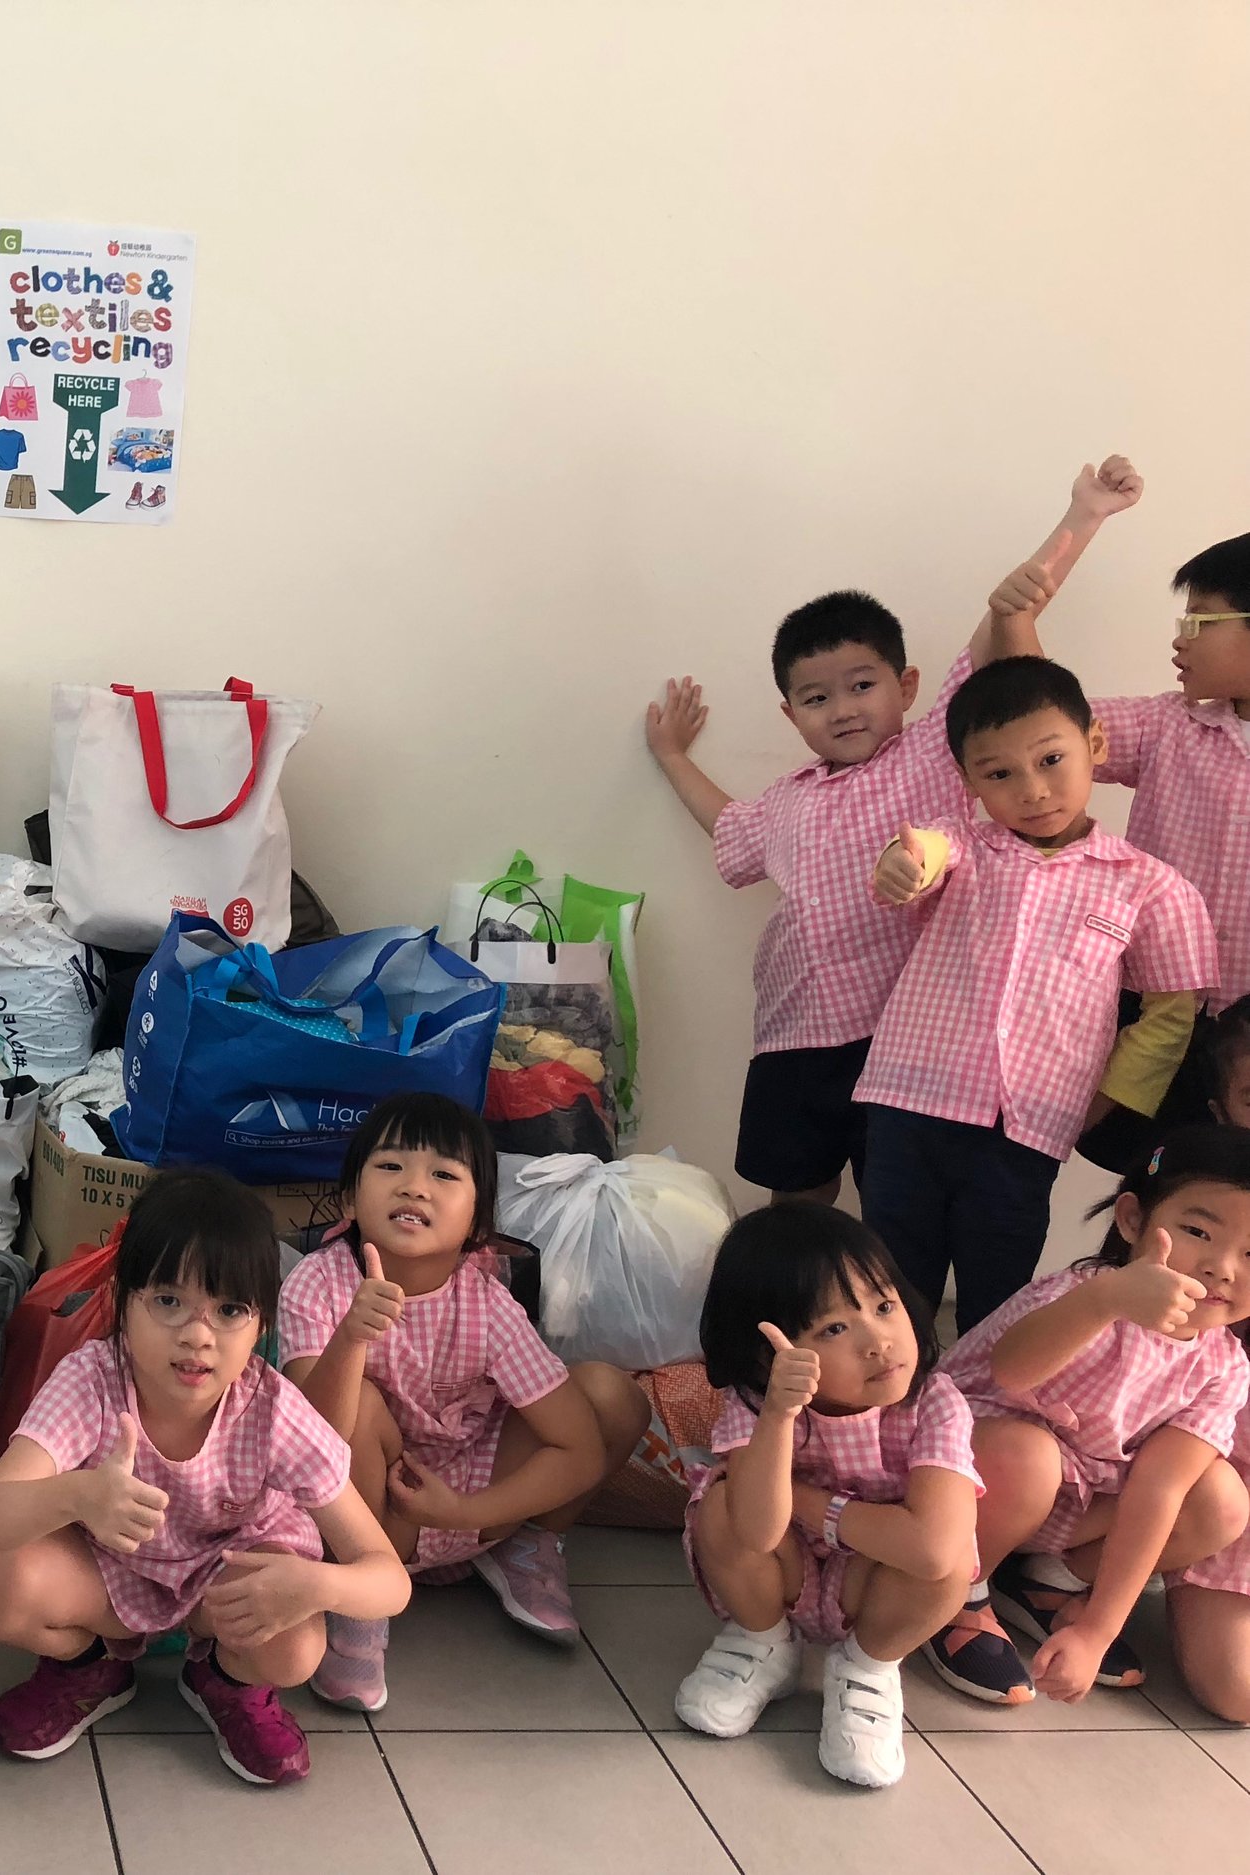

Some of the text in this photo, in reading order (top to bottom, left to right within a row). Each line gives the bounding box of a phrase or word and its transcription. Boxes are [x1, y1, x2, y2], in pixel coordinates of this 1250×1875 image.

[4, 235, 17, 250] G
[147, 253, 188, 262] Kindergarten
[10, 265, 174, 302] clothes &
[10, 298, 173, 333] textiles
[7, 334, 174, 369] recycling
[57, 376, 116, 391] RECYCLE
[68, 395, 102, 408] HERE
[232, 904, 249, 917] SG
[232, 917, 249, 931] 50
[317, 1122, 335, 1132] The
[240, 1134, 261, 1146] Shop
[261, 1138, 286, 1146] online
[286, 1137, 301, 1145] and
[82, 1165, 116, 1186] TISU
[81, 1186, 125, 1209] 10 X 5
